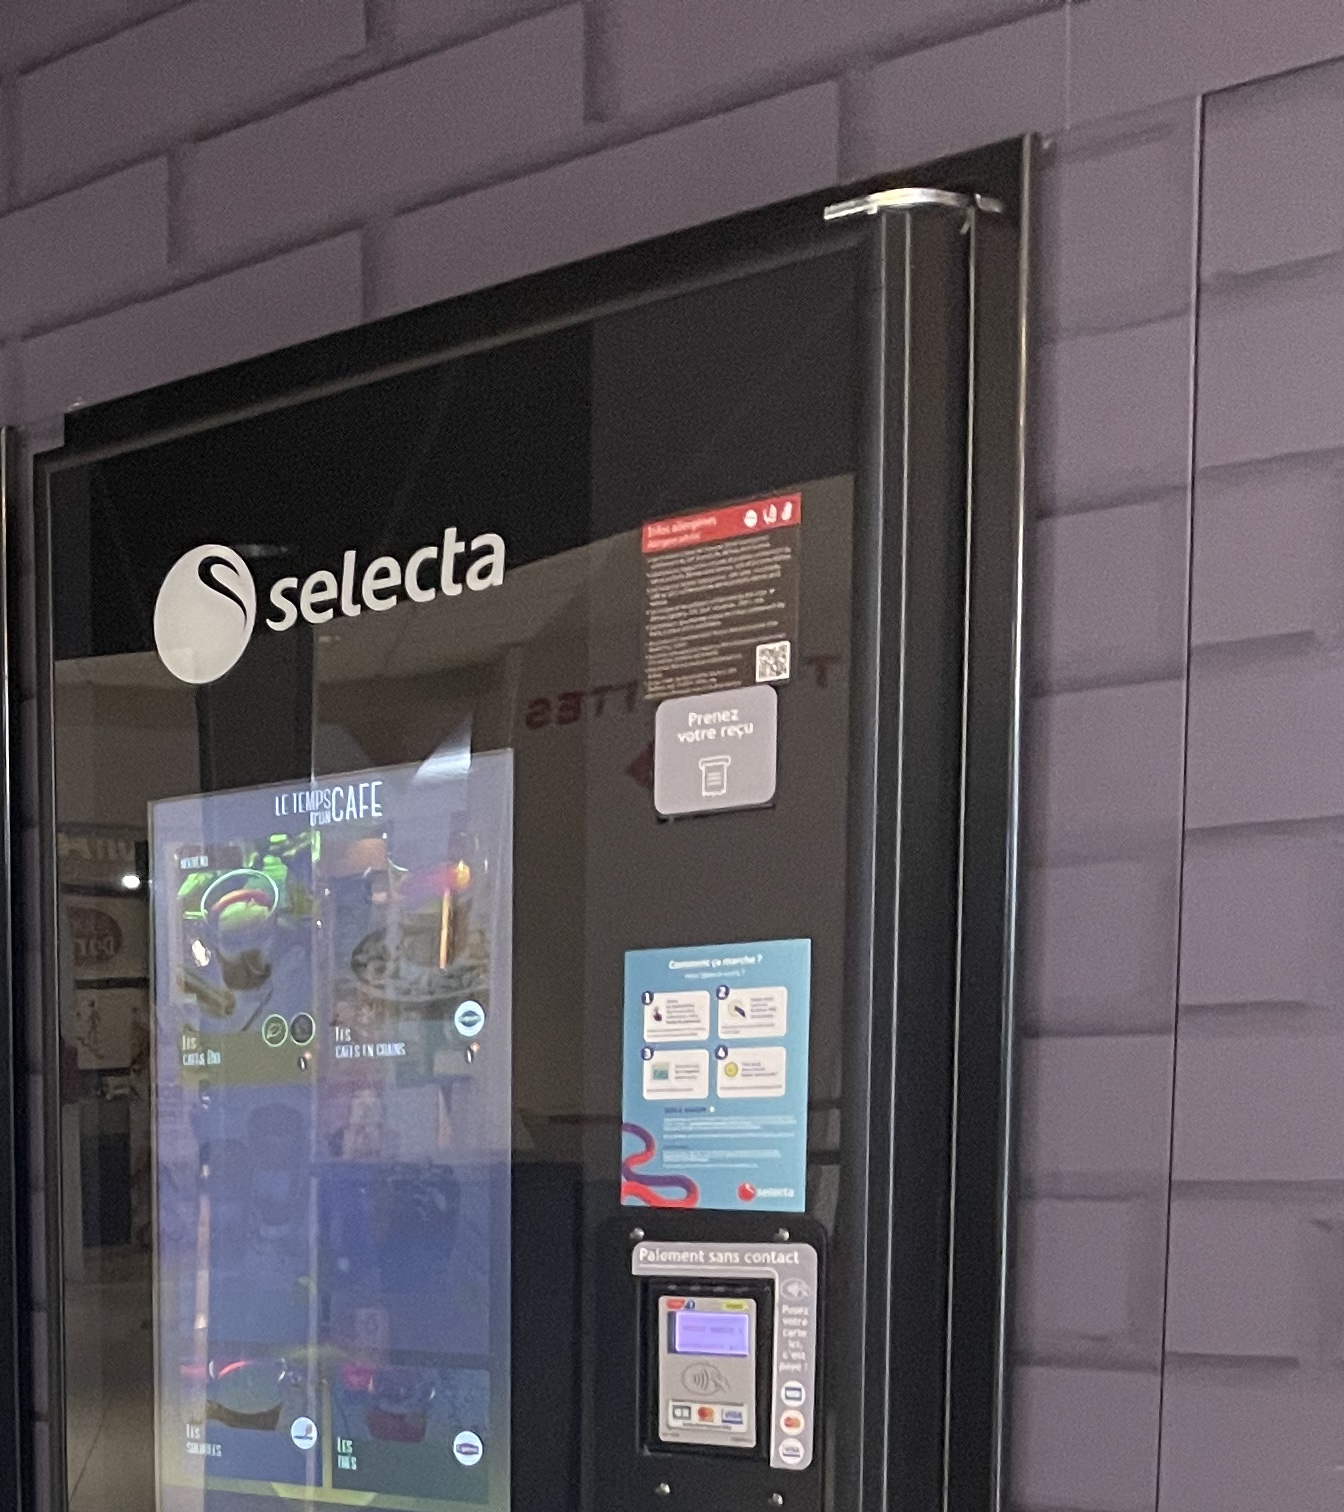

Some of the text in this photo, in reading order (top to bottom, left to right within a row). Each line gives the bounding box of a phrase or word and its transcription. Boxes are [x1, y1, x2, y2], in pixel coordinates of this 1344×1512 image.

[264, 526, 506, 633] selecta
[688, 708, 740, 728] Prenez
[677, 721, 754, 743] votre reçu
[292, 789, 331, 814] TEMPS
[639, 1246, 800, 1265] Paiement sans contact
